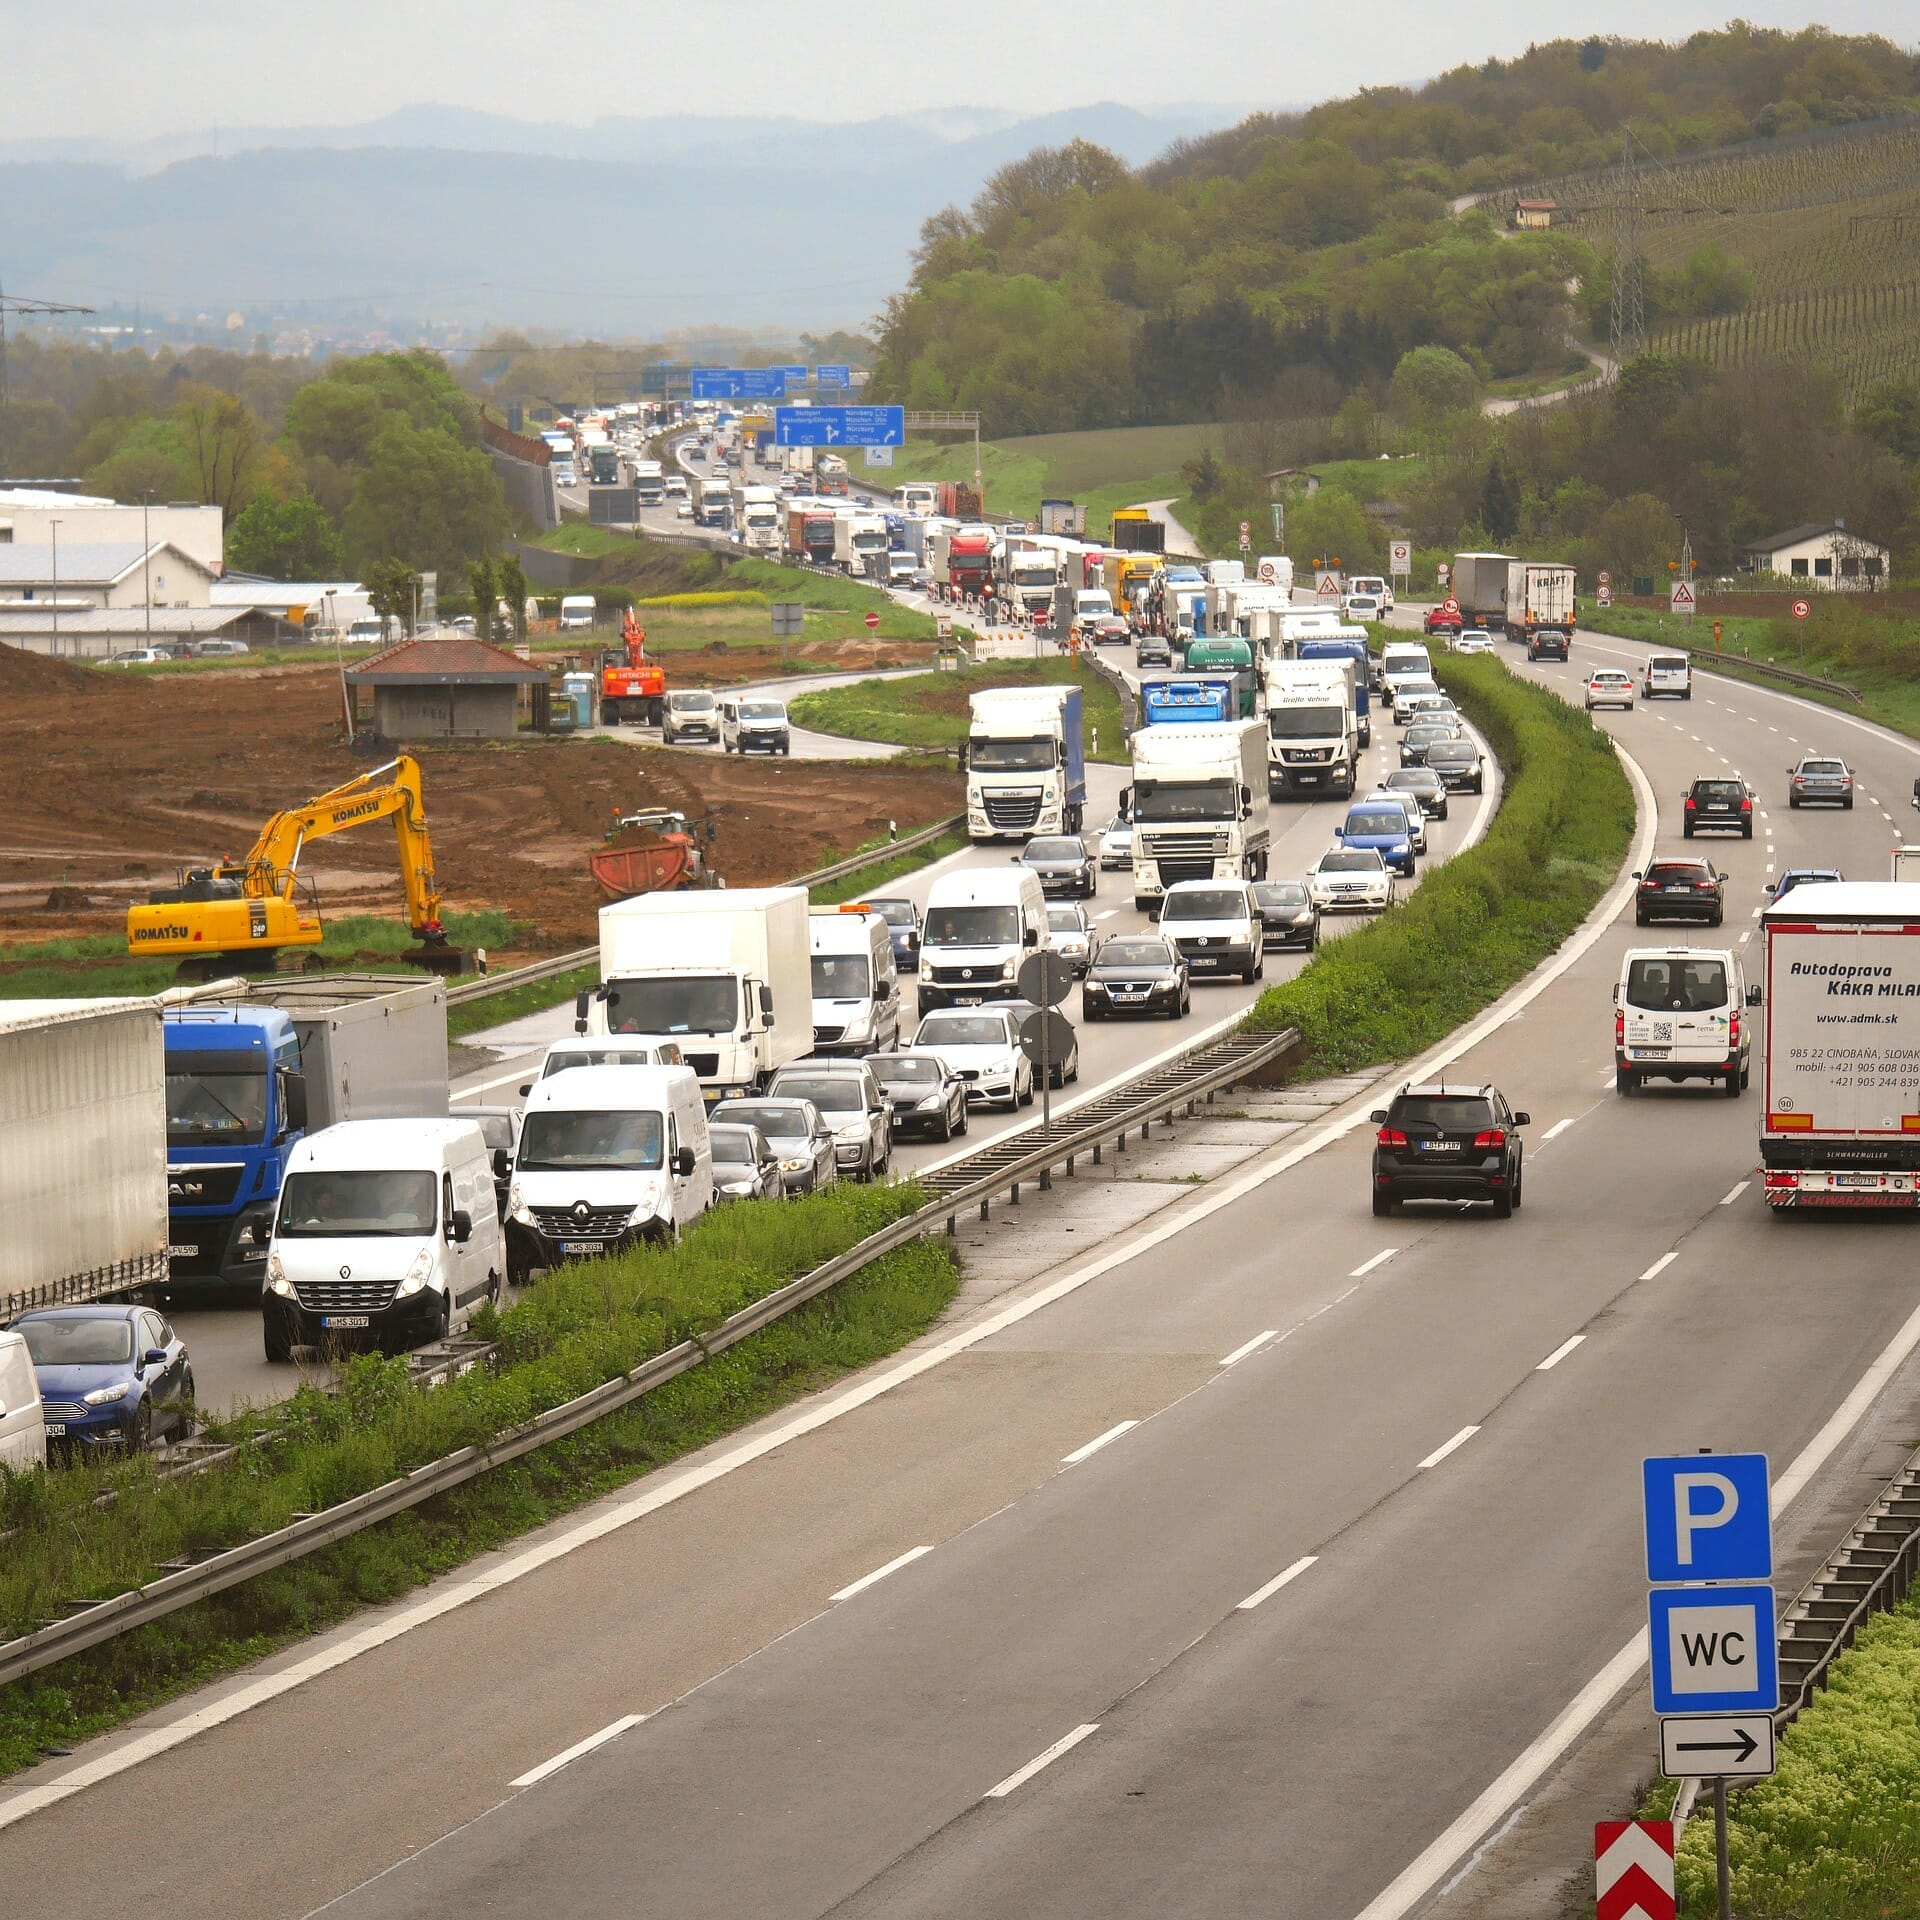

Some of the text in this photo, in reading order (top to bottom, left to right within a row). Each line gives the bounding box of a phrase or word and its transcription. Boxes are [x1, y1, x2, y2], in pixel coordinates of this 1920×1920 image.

[1537, 575, 1566, 588] KRAFT
[619, 671, 650, 679] HITACHI
[333, 801, 379, 823] KOMATSU
[135, 924, 188, 941] KOMATSU
[1791, 962, 1892, 978] Autodoprava
[1827, 980, 1873, 995] KÁKA
[1817, 1013, 1898, 1024] www.admk.sk
[1790, 1048, 1808, 1058] 985
[1811, 1048, 1824, 1058] 22
[1826, 1047, 1881, 1060] CINOBAŇA,
[1795, 1062, 1826, 1071] mobil:
[1830, 1063, 1853, 1072] +421
[1857, 1063, 1875, 1072] 905
[1878, 1063, 1897, 1072] 608
[1830, 1077, 1919, 1087] +421 905 244 839
[348, 1318, 368, 1326] 3017
[1674, 1473, 1739, 1565] P
[1681, 1632, 1745, 1667] WC
